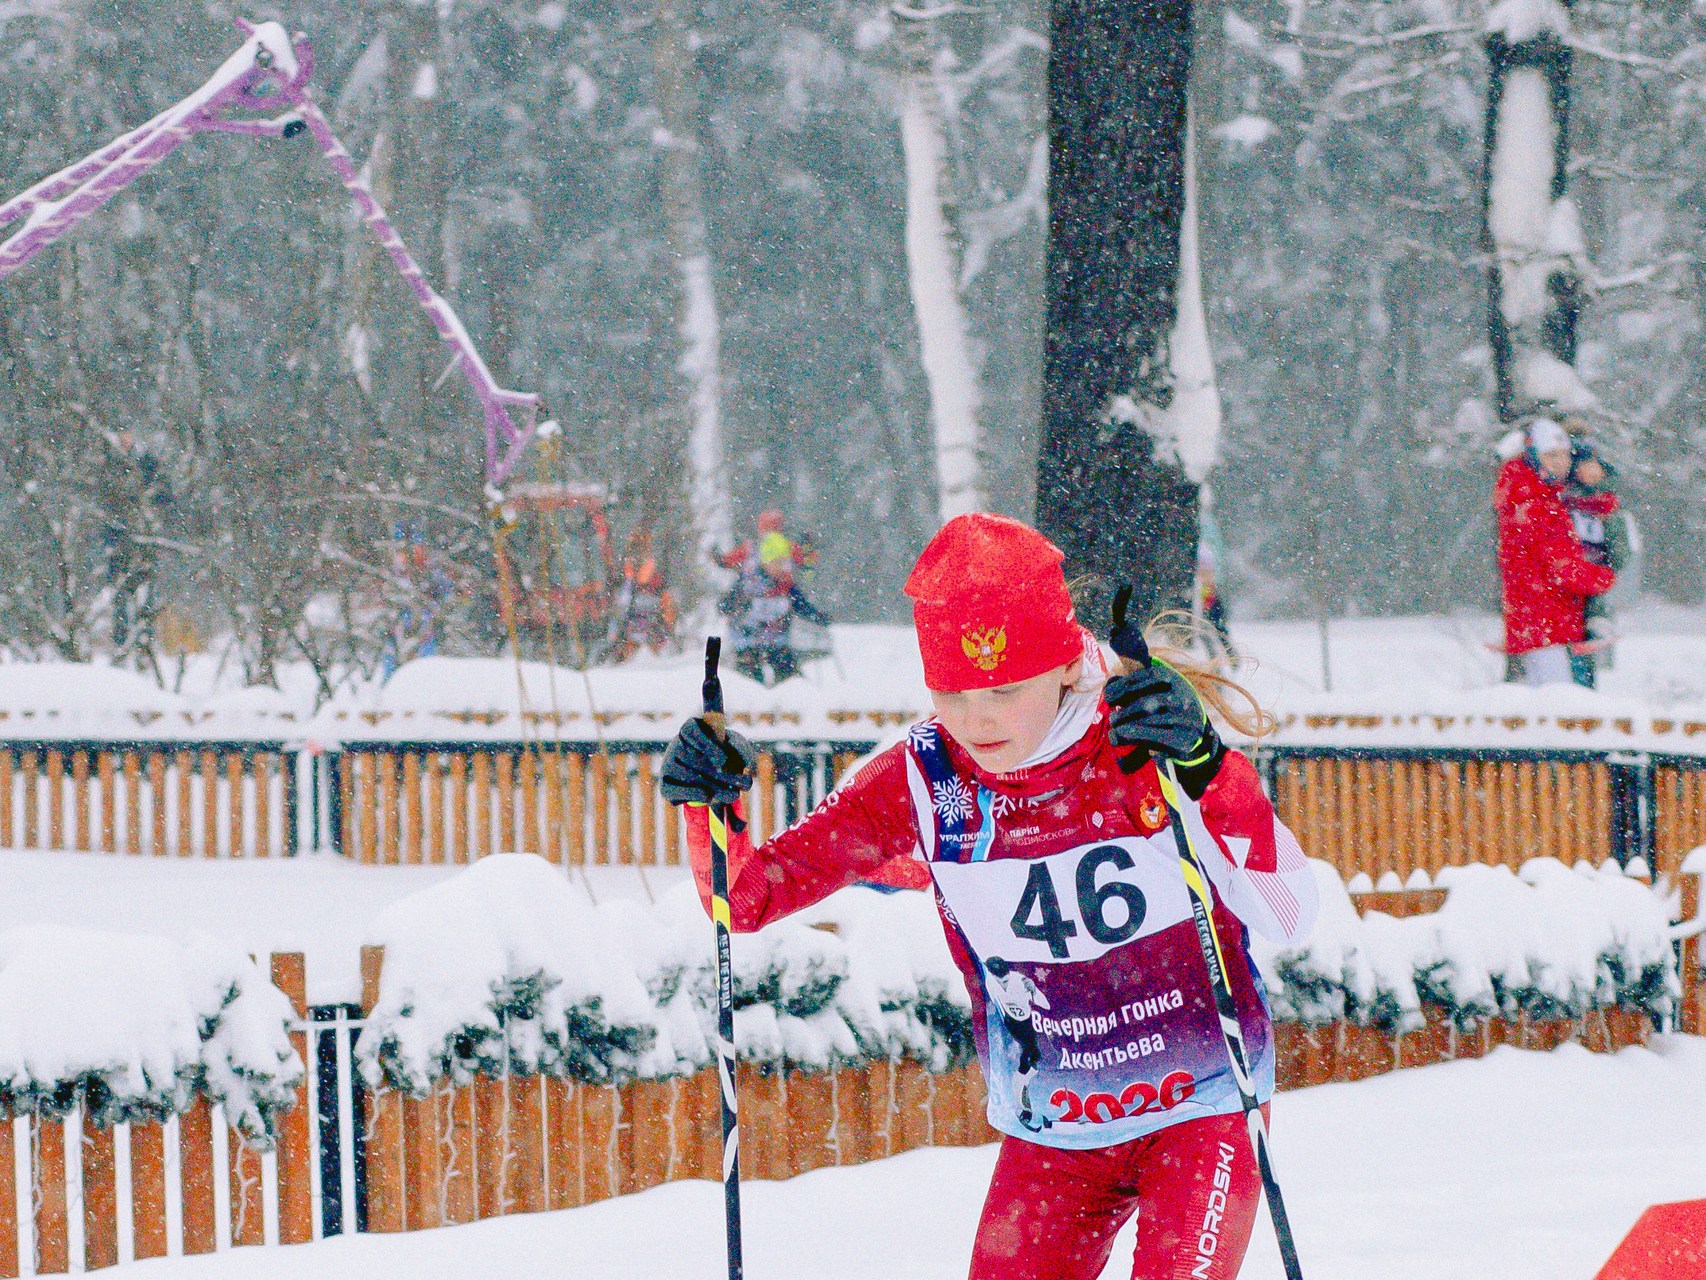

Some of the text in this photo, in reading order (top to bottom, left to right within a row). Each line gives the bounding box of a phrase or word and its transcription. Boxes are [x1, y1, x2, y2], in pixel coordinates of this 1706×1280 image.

[939, 831, 990, 842] УРАЛХИМ
[1009, 825, 1040, 838] ПАРКИ
[1010, 844, 1147, 959] 46
[1031, 988, 1184, 1042] Вечерняя гонка
[1059, 1033, 1166, 1071] Акентьева
[1049, 1071, 1195, 1124] 2026
[1191, 1141, 1235, 1280] NORDSKI
